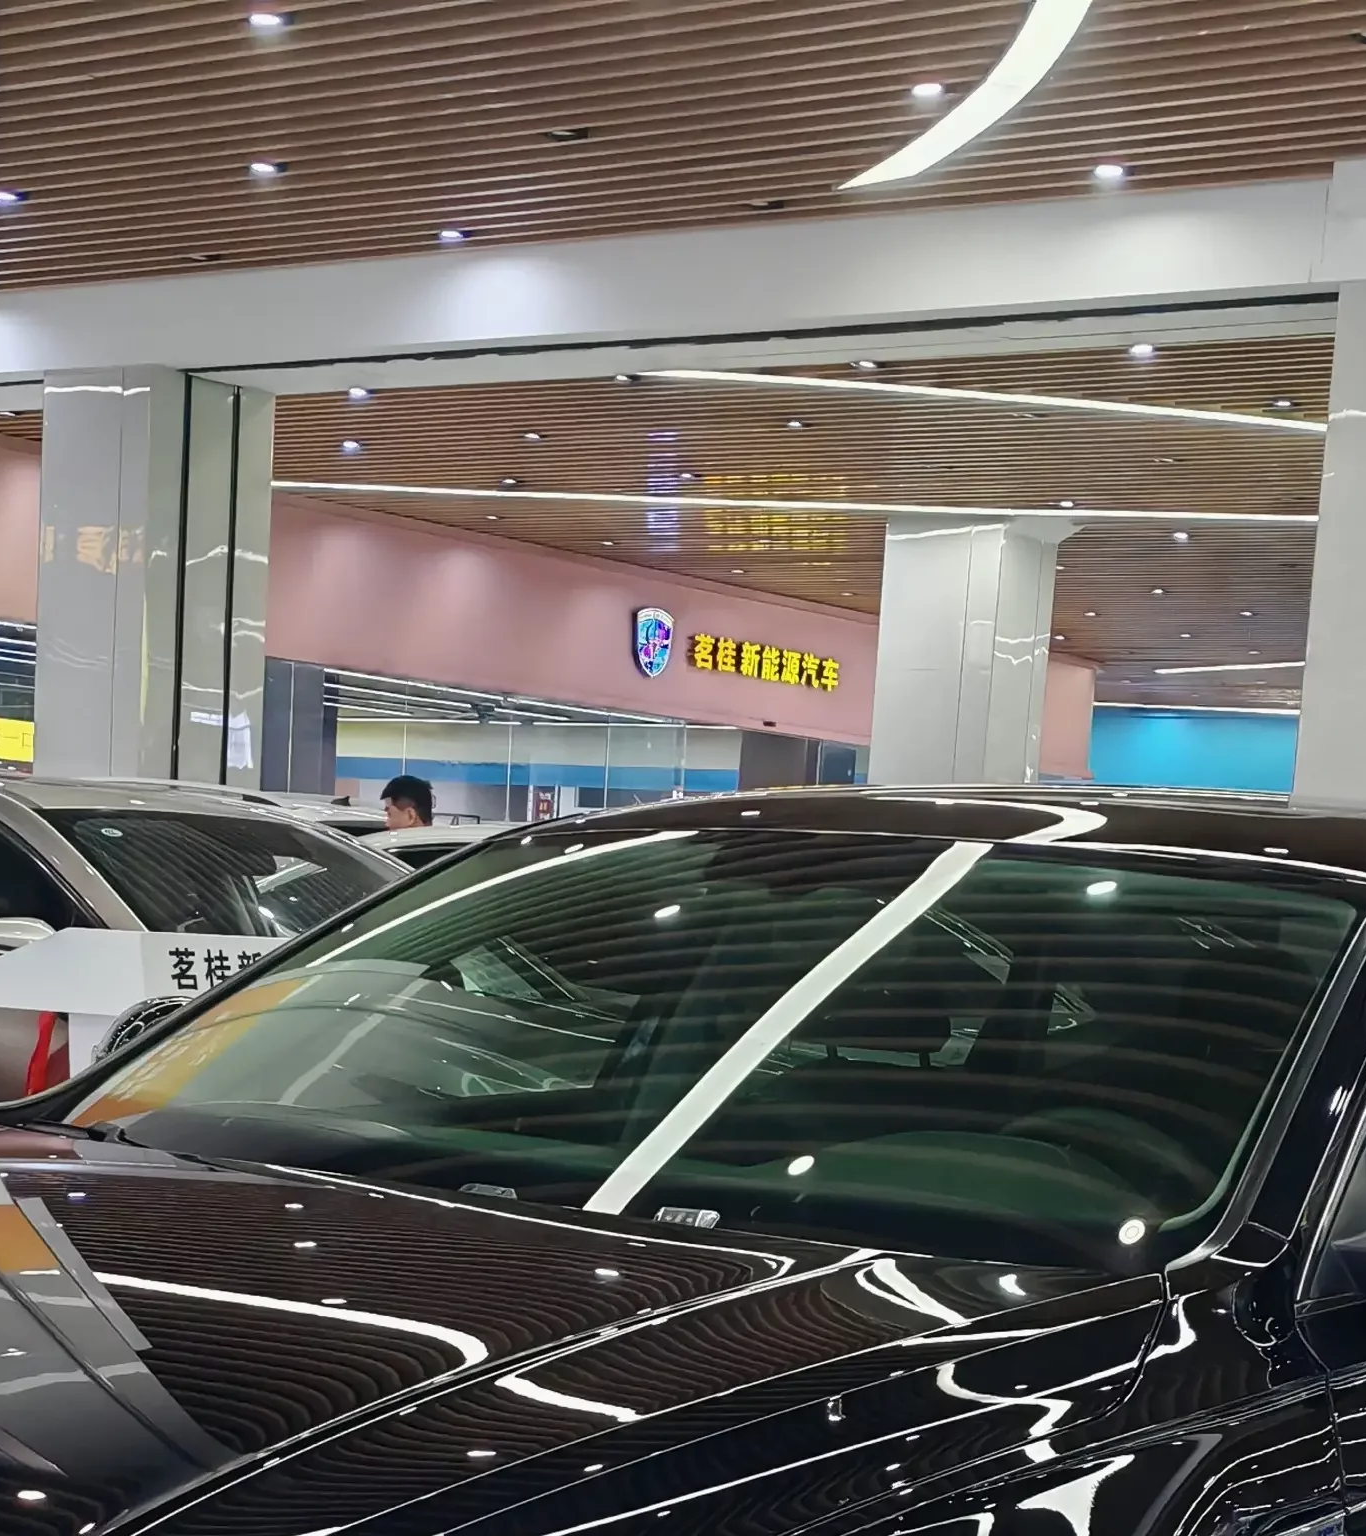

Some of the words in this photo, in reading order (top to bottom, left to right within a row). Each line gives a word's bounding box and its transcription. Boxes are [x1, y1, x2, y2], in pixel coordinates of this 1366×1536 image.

[693, 632, 840, 692] 茗桂新能源汽车
